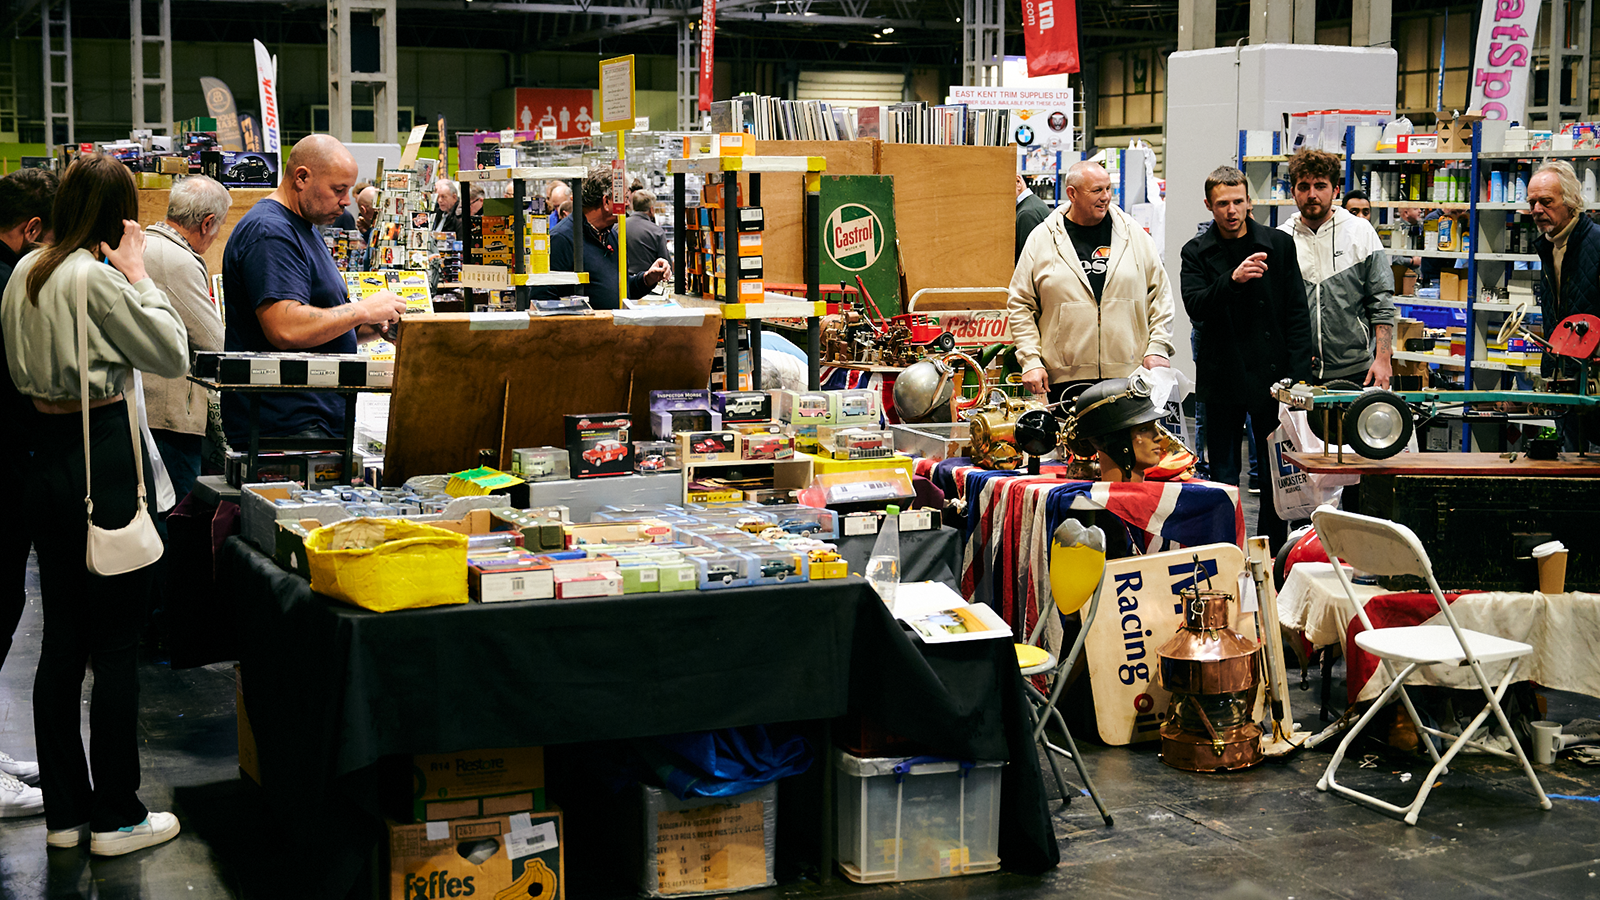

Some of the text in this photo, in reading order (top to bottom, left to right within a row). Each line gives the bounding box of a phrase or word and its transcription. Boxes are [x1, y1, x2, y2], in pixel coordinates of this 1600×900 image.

[1038, 1, 1055, 35] LTD.
[955, 90, 975, 98] EAST
[1020, 91, 1054, 99] SUPPLIES
[501, 132, 514, 140] FORD
[835, 218, 873, 249] Castrol
[463, 270, 506, 282] Vanguards
[946, 316, 1009, 338] Castrol
[1277, 473, 1307, 489] LANCASTER
[1114, 570, 1152, 685] Racing
[1134, 693, 1166, 733] oil
[431, 758, 504, 771] R14 Restore
